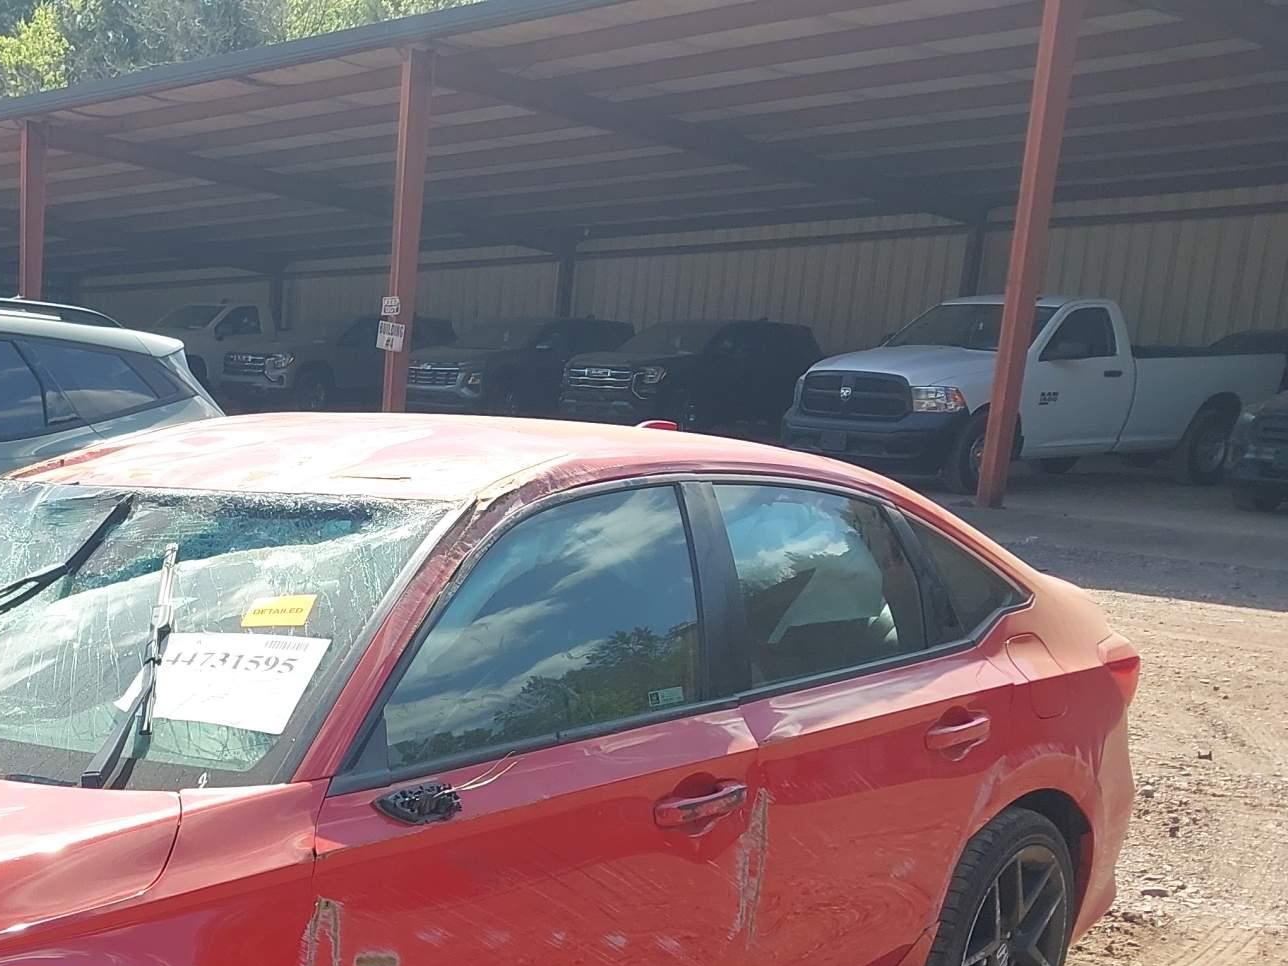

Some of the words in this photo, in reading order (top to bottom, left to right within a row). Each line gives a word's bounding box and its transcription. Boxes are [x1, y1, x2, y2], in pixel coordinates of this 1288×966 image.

[379, 322, 404, 338] BUILDING
[253, 607, 304, 615] DETAILED
[166, 651, 299, 674] 44731595
